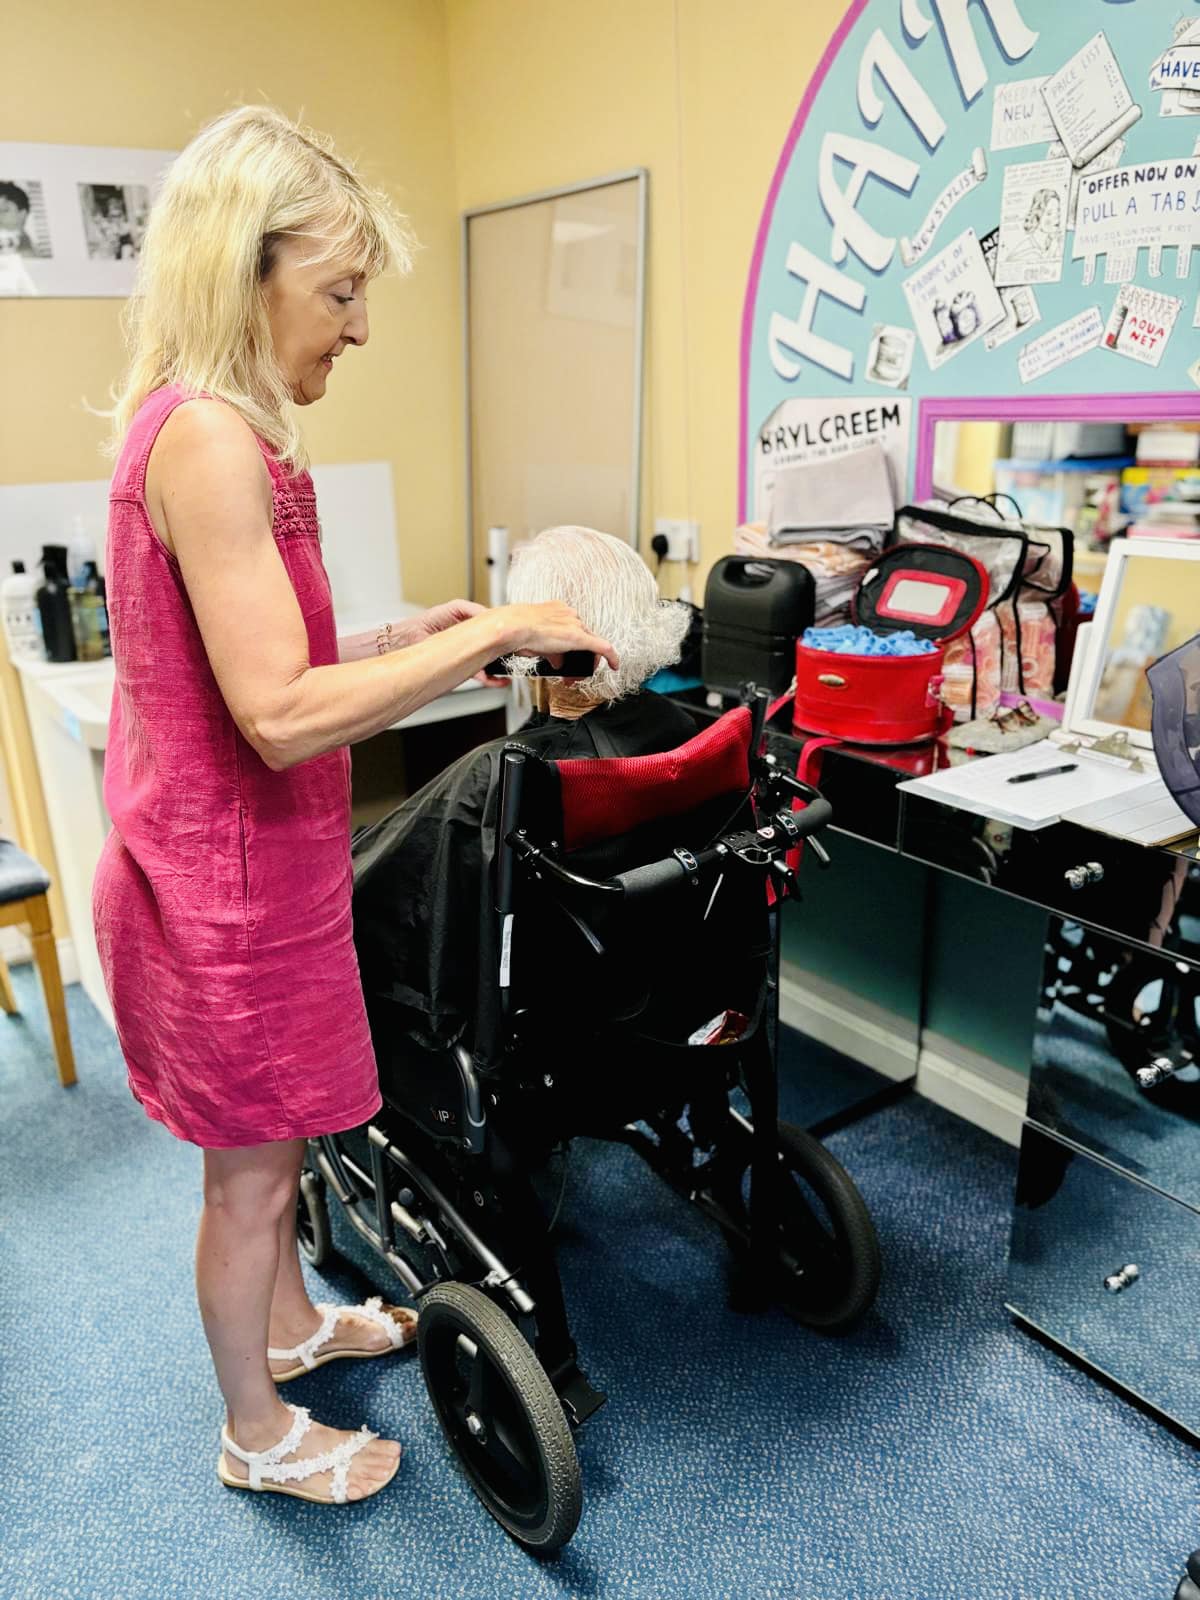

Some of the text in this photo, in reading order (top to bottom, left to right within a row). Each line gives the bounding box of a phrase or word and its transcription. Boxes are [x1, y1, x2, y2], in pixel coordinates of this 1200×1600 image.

[1050, 69, 1078, 99] PRICE
[1081, 44, 1103, 69] LIST
[1003, 103, 1035, 122] NEW
[1088, 164, 1198, 195] OFFER NOW ON
[1083, 201, 1118, 224] PULL
[1125, 196, 1138, 215] A
[911, 219, 936, 255] NEW
[1129, 316, 1165, 338] AQUA
[1129, 331, 1158, 350] NET
[760, 403, 902, 455] BRYLCREEM
